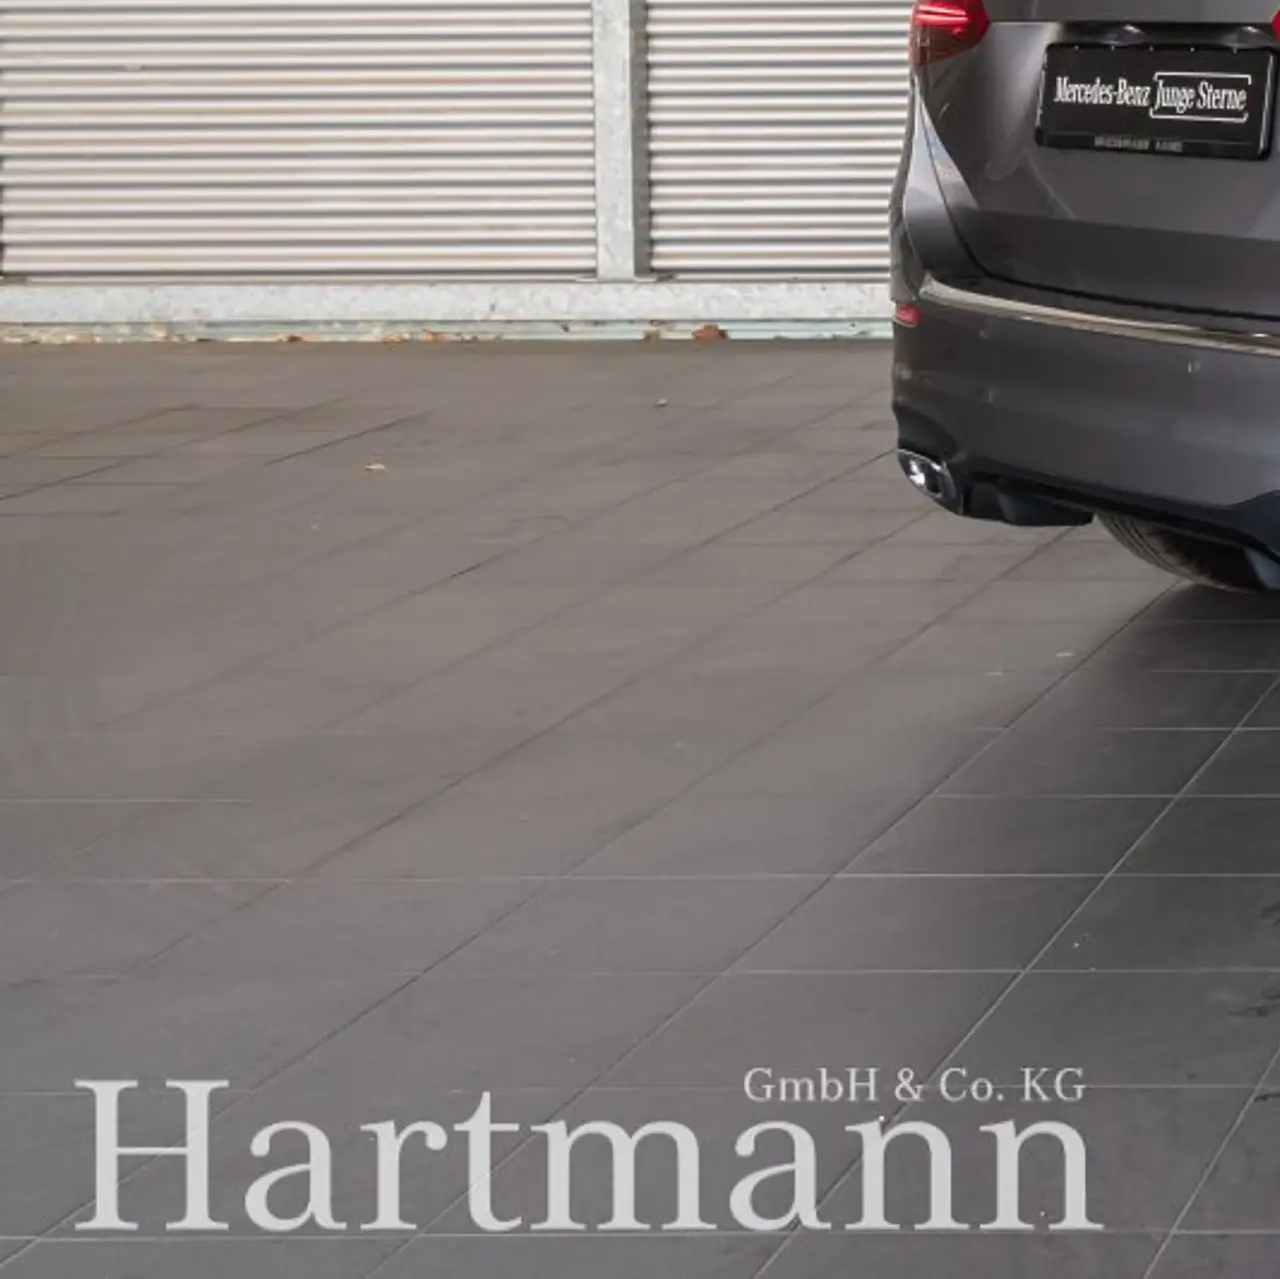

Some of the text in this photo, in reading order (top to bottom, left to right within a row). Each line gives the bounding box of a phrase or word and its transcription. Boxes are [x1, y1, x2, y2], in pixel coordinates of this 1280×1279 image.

[1053, 76, 1248, 113] Mercedes-Benz Junge Sterne
